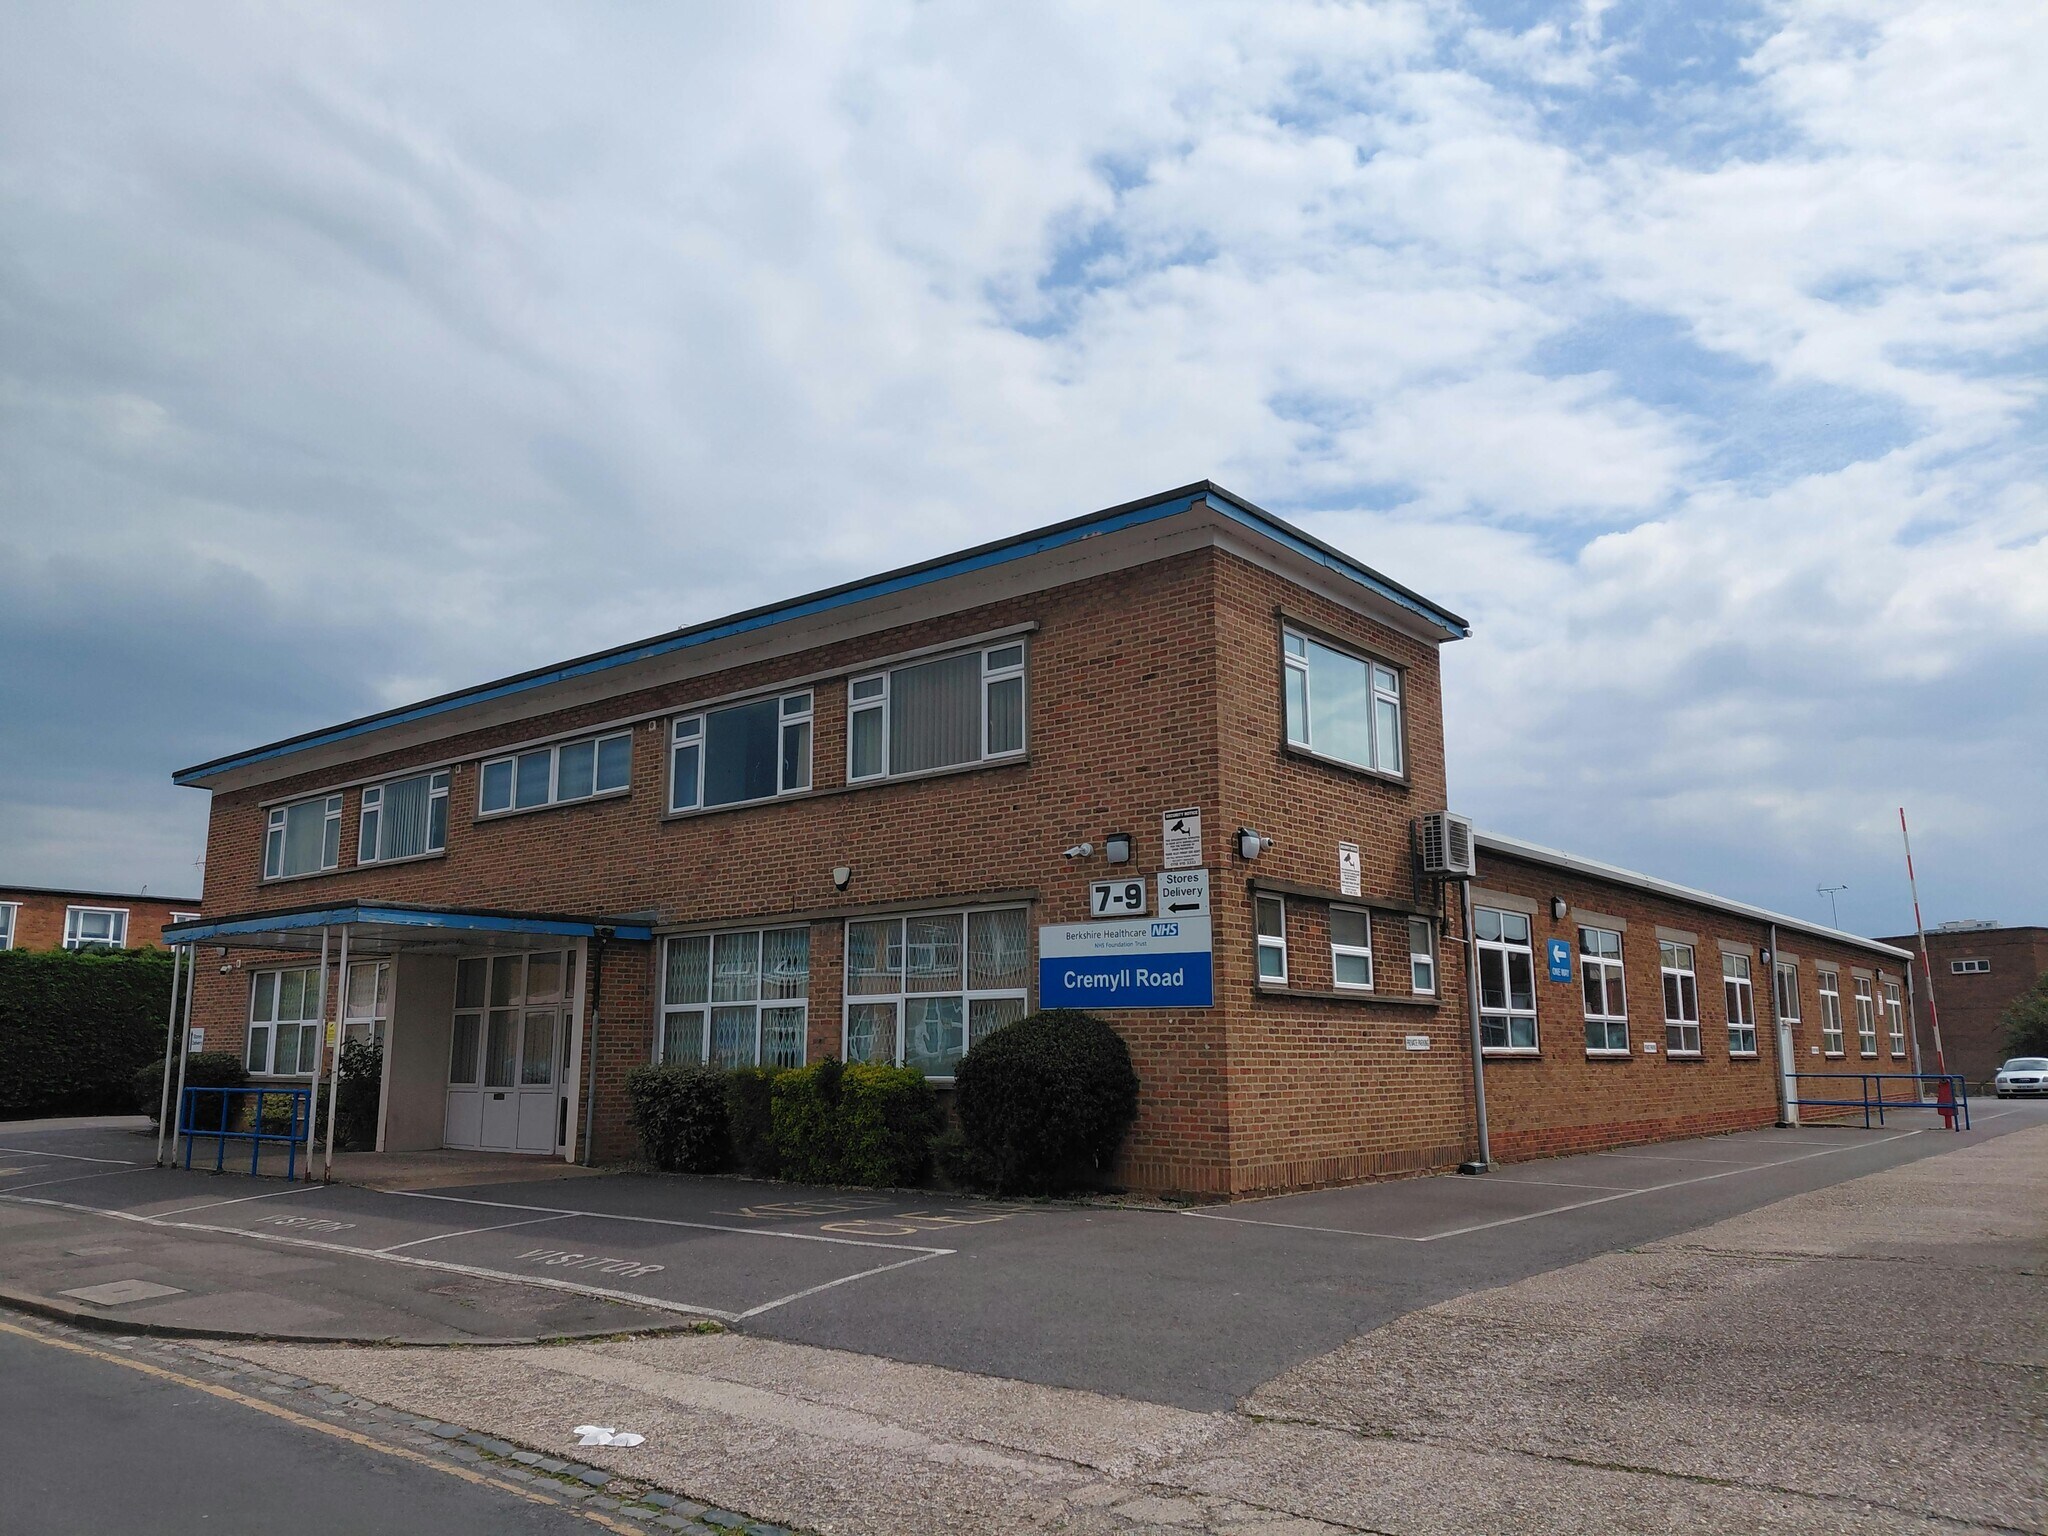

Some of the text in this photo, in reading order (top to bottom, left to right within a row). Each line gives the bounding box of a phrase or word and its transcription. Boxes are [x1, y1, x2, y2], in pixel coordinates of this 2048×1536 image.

[1166, 873, 1199, 885] Stores
[1095, 883, 1142, 912] 7-9
[1162, 886, 1203, 898] Delivery
[1066, 923, 1178, 941] Berkshire Healthcare NHS
[1063, 967, 1184, 992] Cremyll Road
[255, 1214, 357, 1233] VISITOR
[514, 1249, 665, 1278] VISITOR
